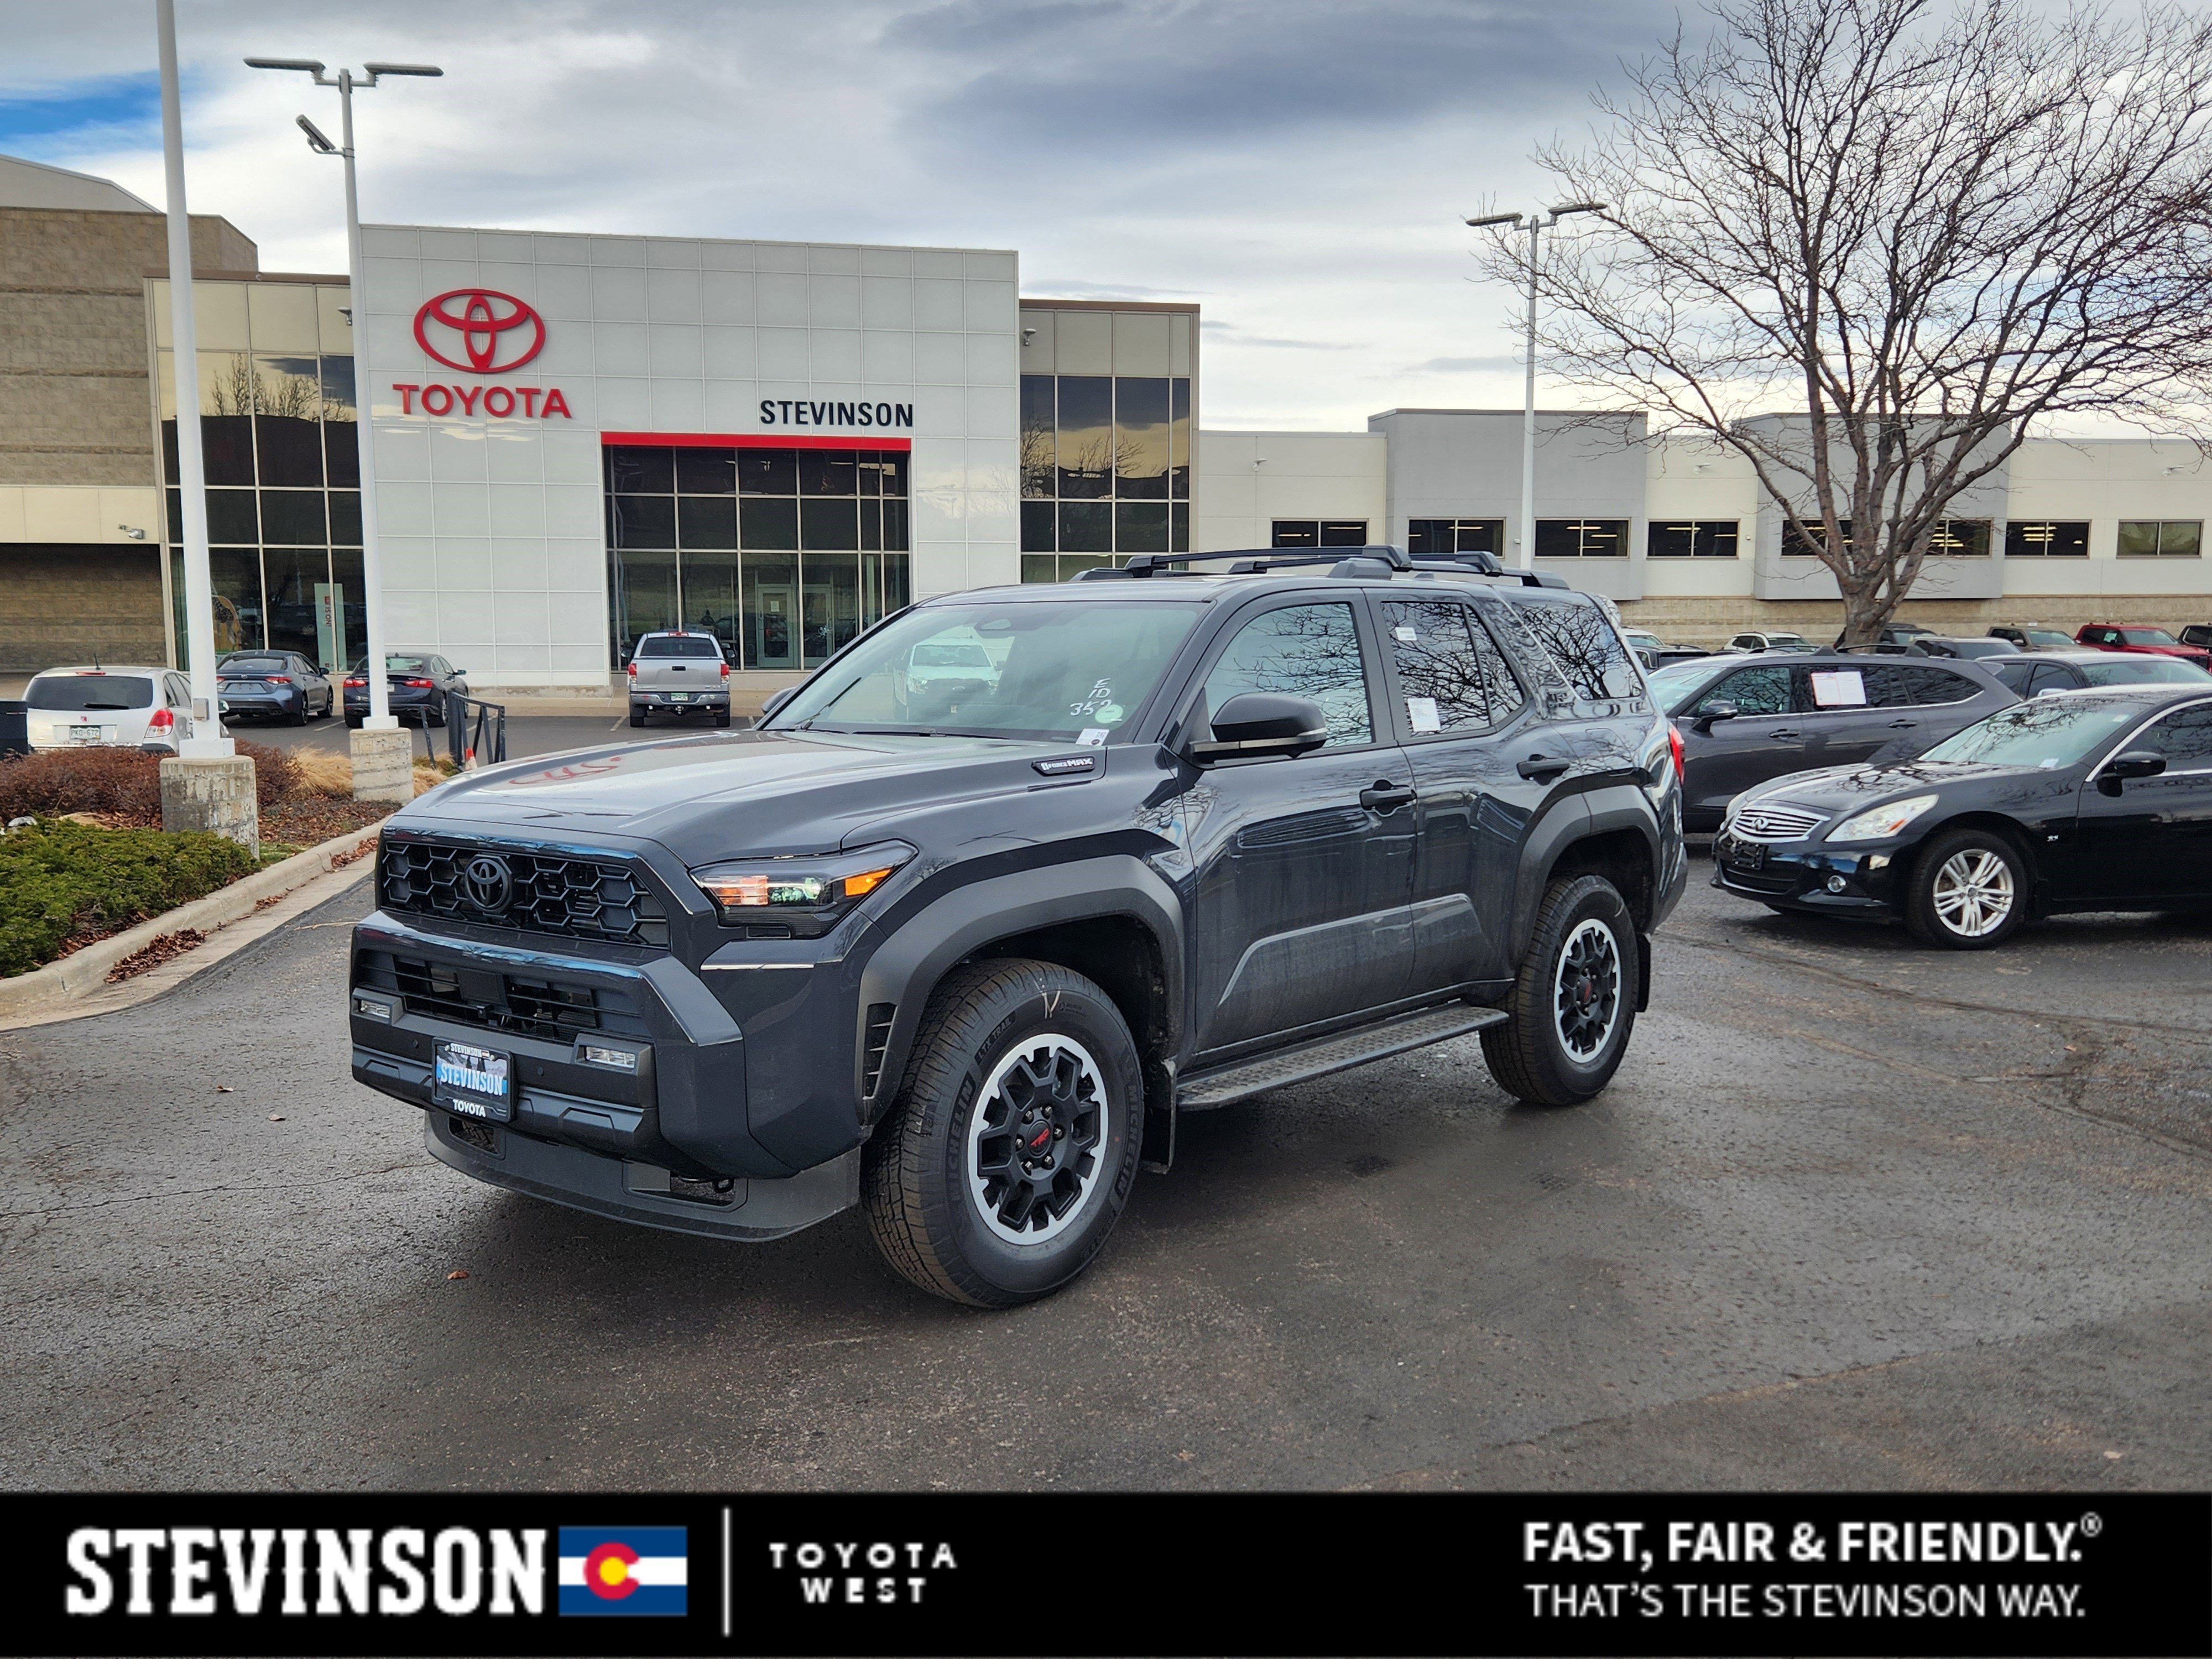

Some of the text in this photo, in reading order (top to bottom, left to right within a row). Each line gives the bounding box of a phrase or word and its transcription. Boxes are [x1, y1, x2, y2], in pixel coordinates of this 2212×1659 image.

[392, 384, 572, 419] TOYOTA
[760, 400, 914, 427] STEVINSON
[1094, 677, 1111, 688] E
[450, 1043, 482, 1057] STEVINSON
[441, 1062, 504, 1096] STEVINSON
[452, 1099, 486, 1118] TOYOTA
